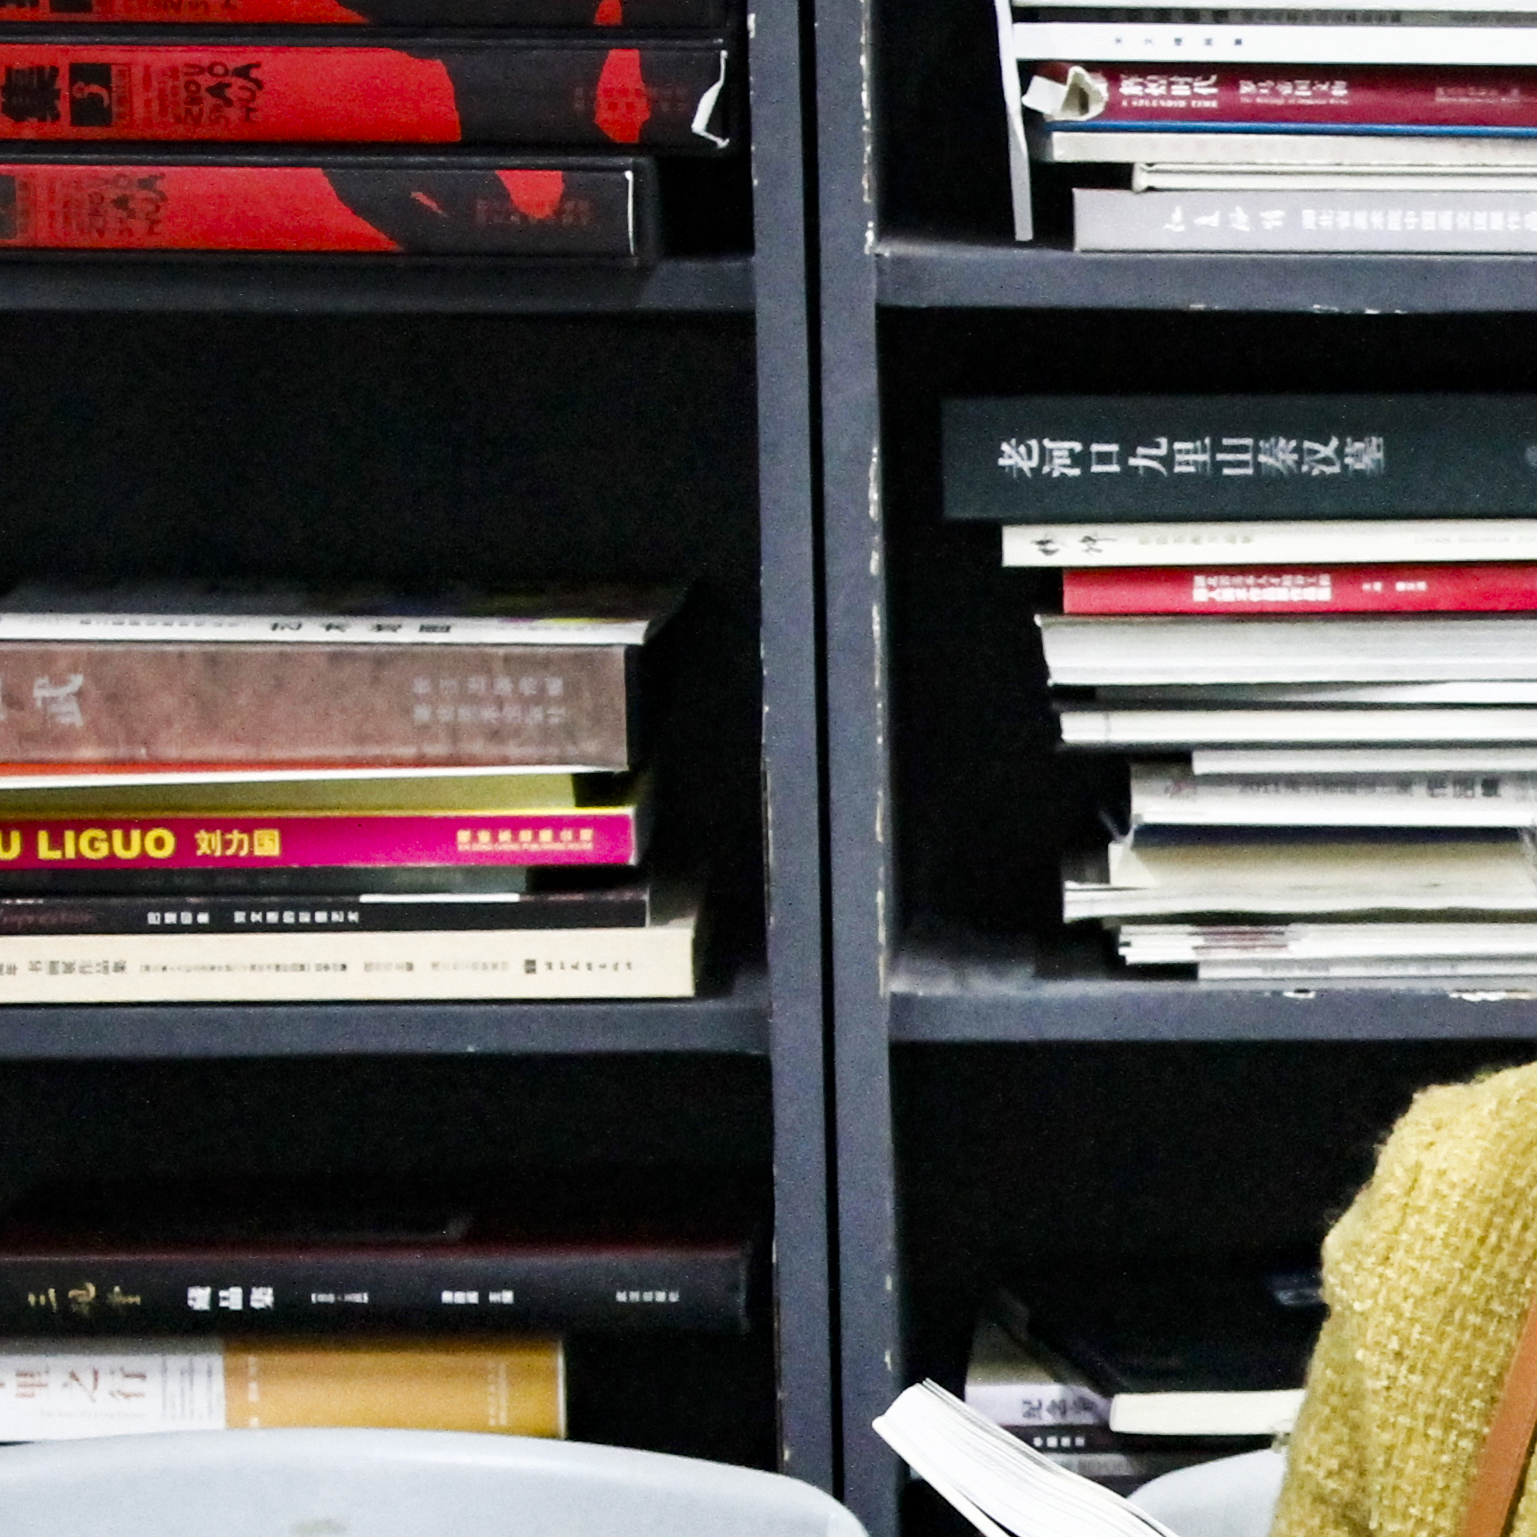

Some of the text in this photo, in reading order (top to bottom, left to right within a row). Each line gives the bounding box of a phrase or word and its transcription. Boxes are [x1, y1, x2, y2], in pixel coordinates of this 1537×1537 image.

[998, 436, 1385, 478] 老河口九里山秦汉墓
[37, 828, 176, 860] LIGUO
[195, 828, 281, 858] 刘力国
[0, 1362, 148, 1404] 里之行
